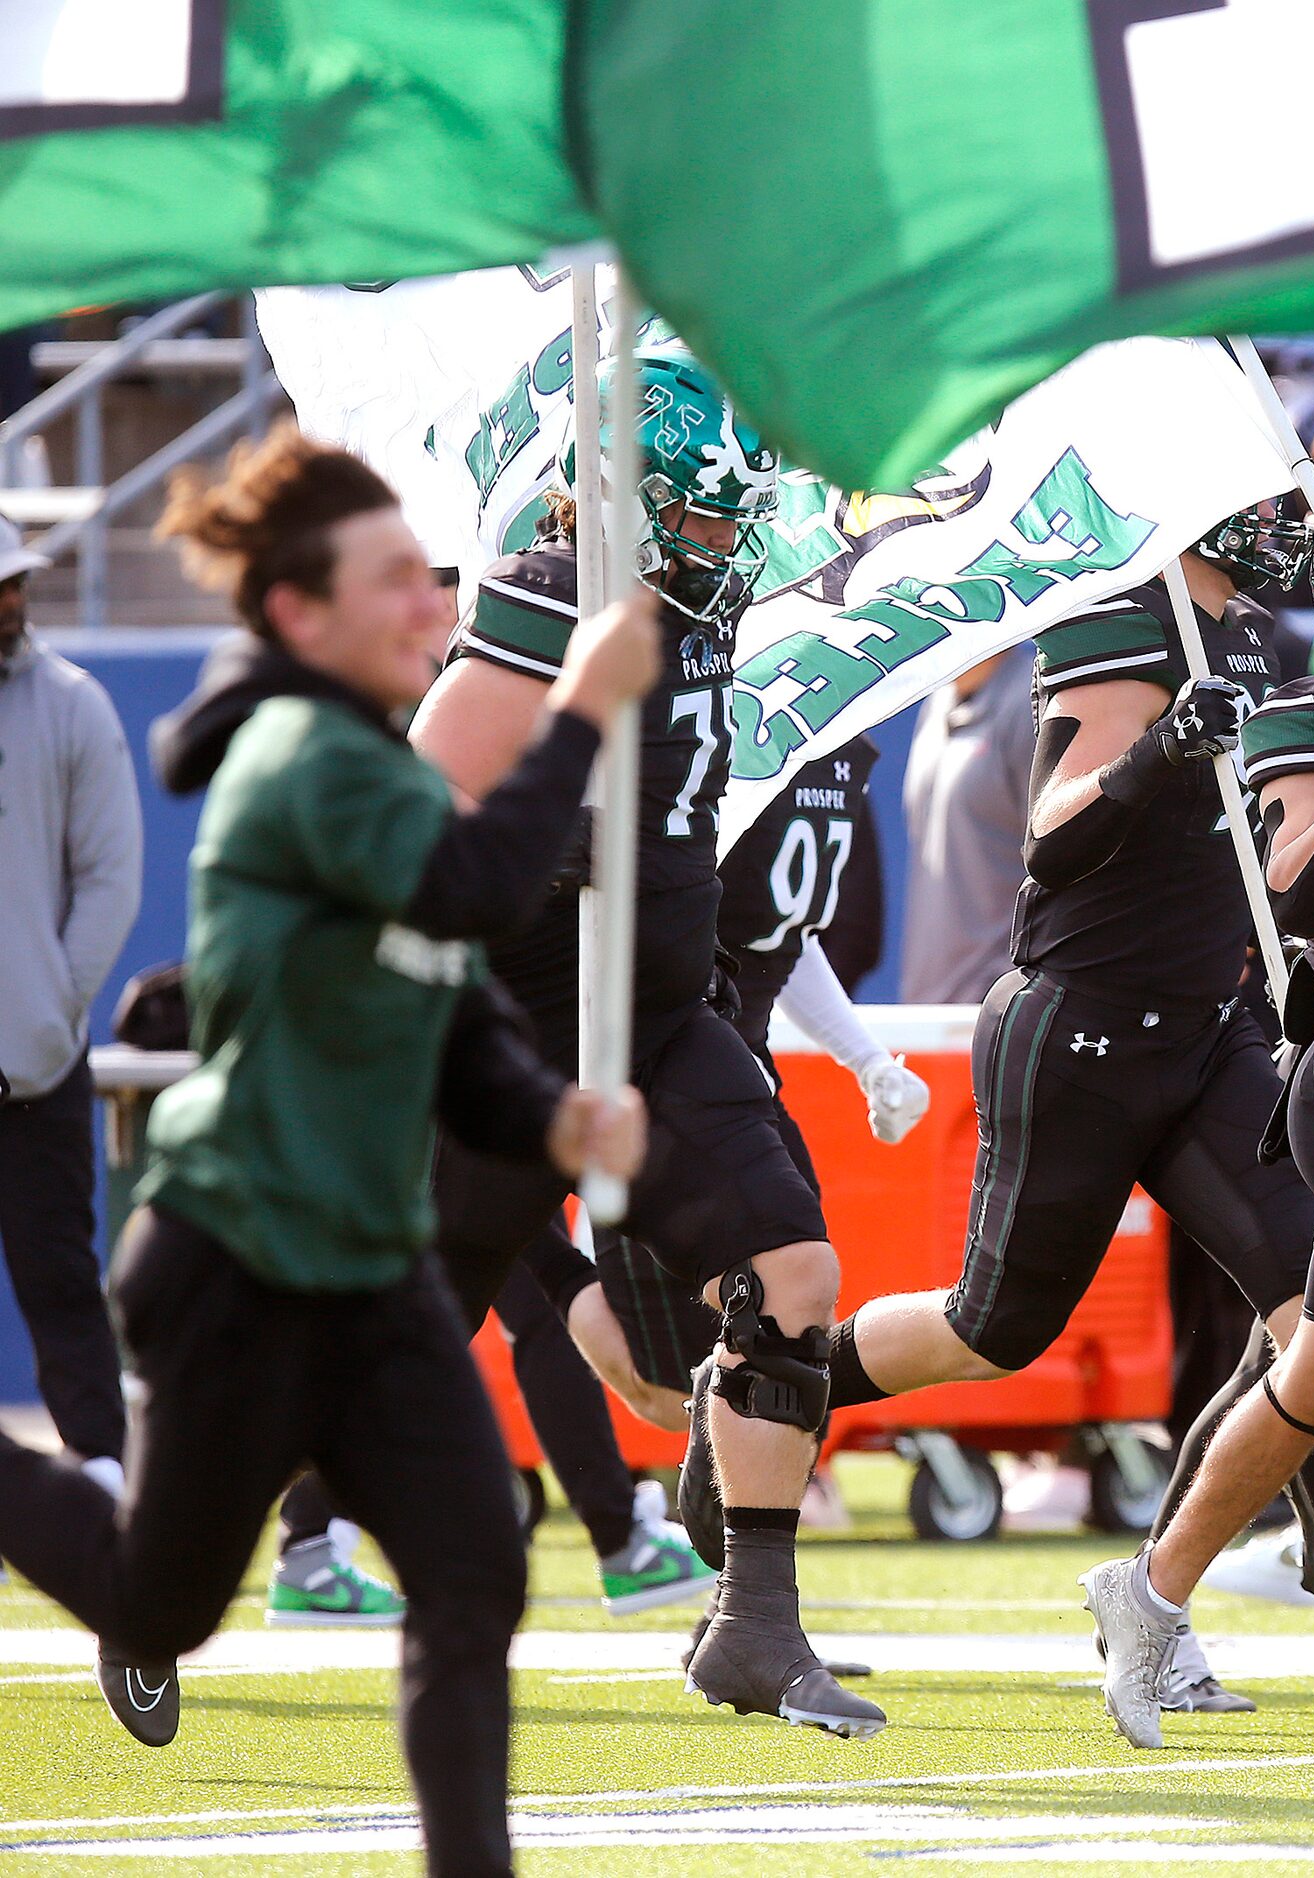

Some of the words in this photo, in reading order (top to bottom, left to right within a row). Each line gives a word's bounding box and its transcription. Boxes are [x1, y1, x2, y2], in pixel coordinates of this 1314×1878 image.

[1225, 653, 1270, 675] PROSPER
[795, 787, 846, 810] PROSPER
[746, 816, 853, 953] 97
